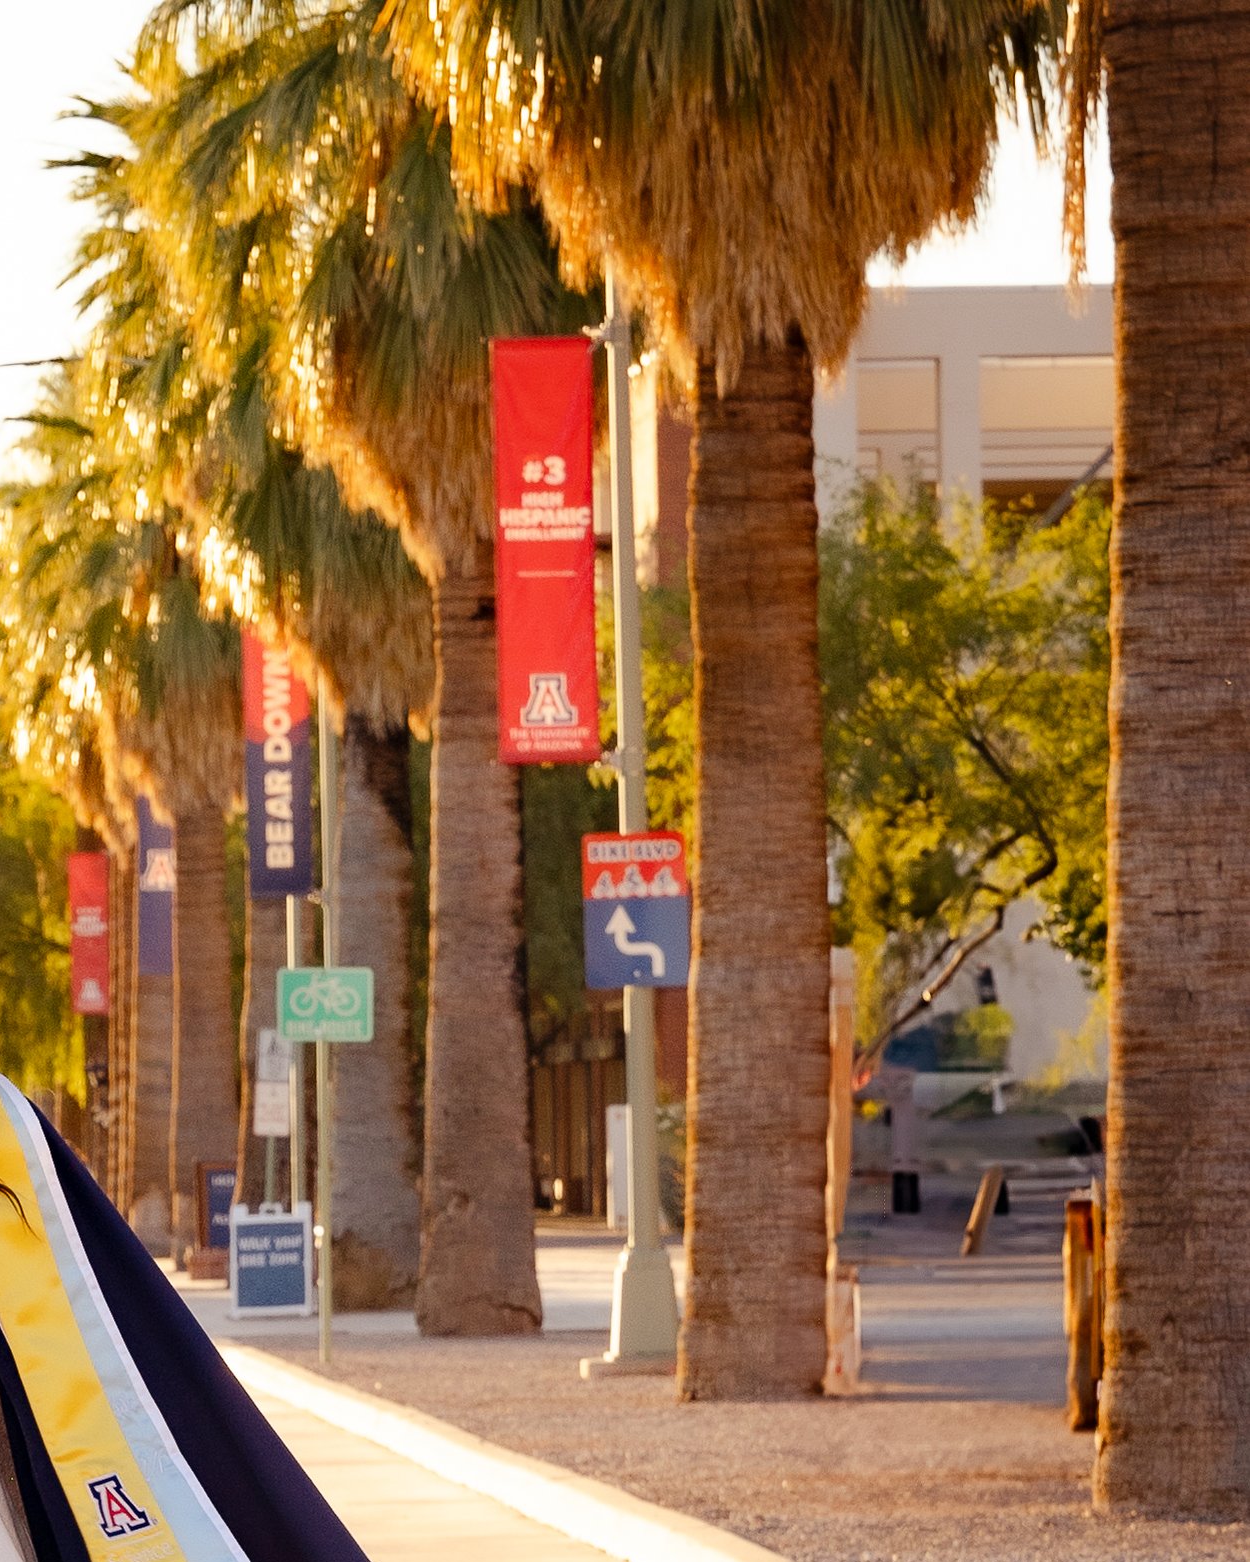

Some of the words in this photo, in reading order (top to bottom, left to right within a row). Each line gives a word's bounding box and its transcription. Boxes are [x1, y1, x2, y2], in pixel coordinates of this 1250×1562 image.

[521, 455, 566, 486] #3
[499, 507, 591, 528] HISPANIC
[262, 649, 292, 763] DOWN
[520, 673, 578, 727] A
[264, 769, 294, 869] BEAR
[588, 841, 630, 863] BIKE
[632, 839, 681, 861] BLVD
[87, 1472, 150, 1539] A
